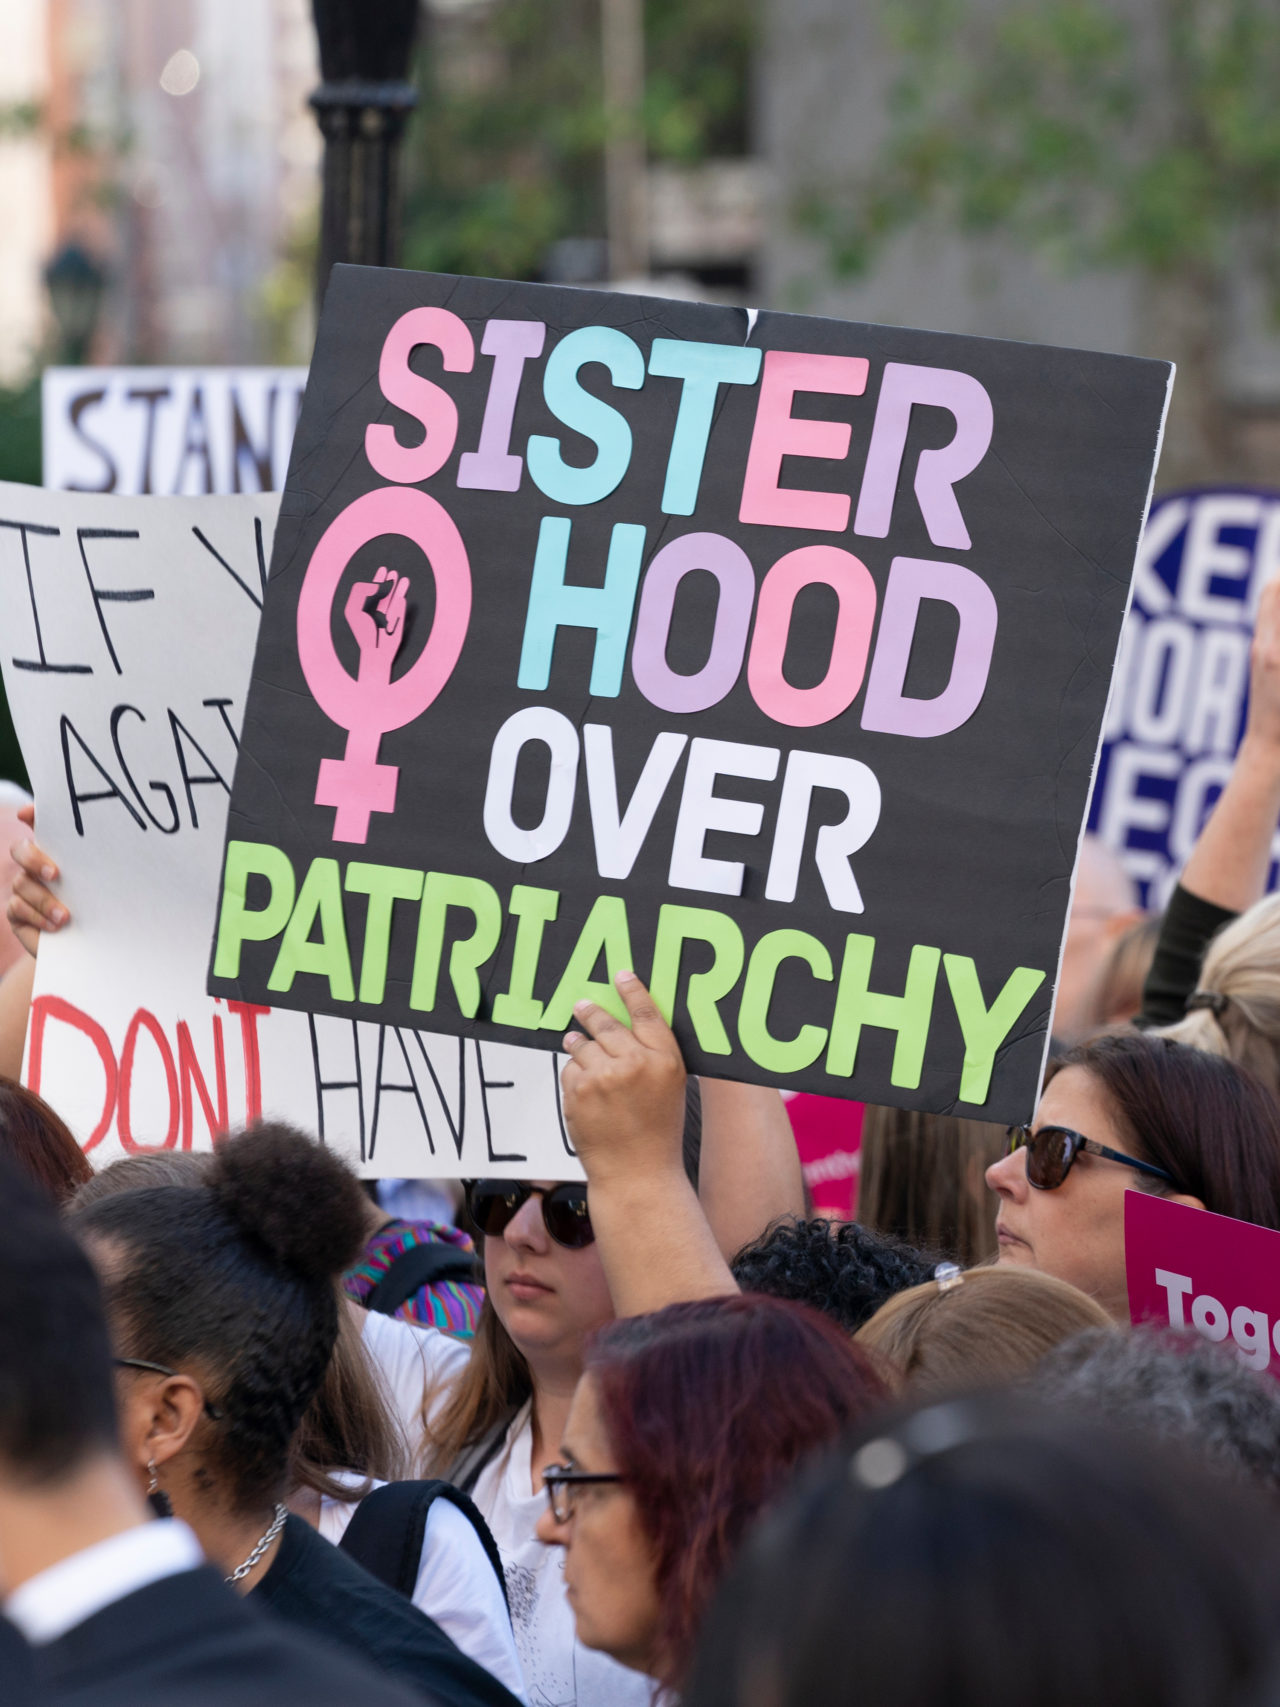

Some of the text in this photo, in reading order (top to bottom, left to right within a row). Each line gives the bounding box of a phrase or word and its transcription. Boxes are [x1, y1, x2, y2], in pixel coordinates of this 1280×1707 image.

[65, 385, 305, 494] STAN
[364, 306, 995, 550] SISTER
[0, 519, 155, 676] IF
[516, 515, 999, 738] HOOD
[483, 706, 883, 914] OVER
[213, 840, 1047, 1106] PATRIARCHY
[308, 1011, 528, 1163] HAVE
